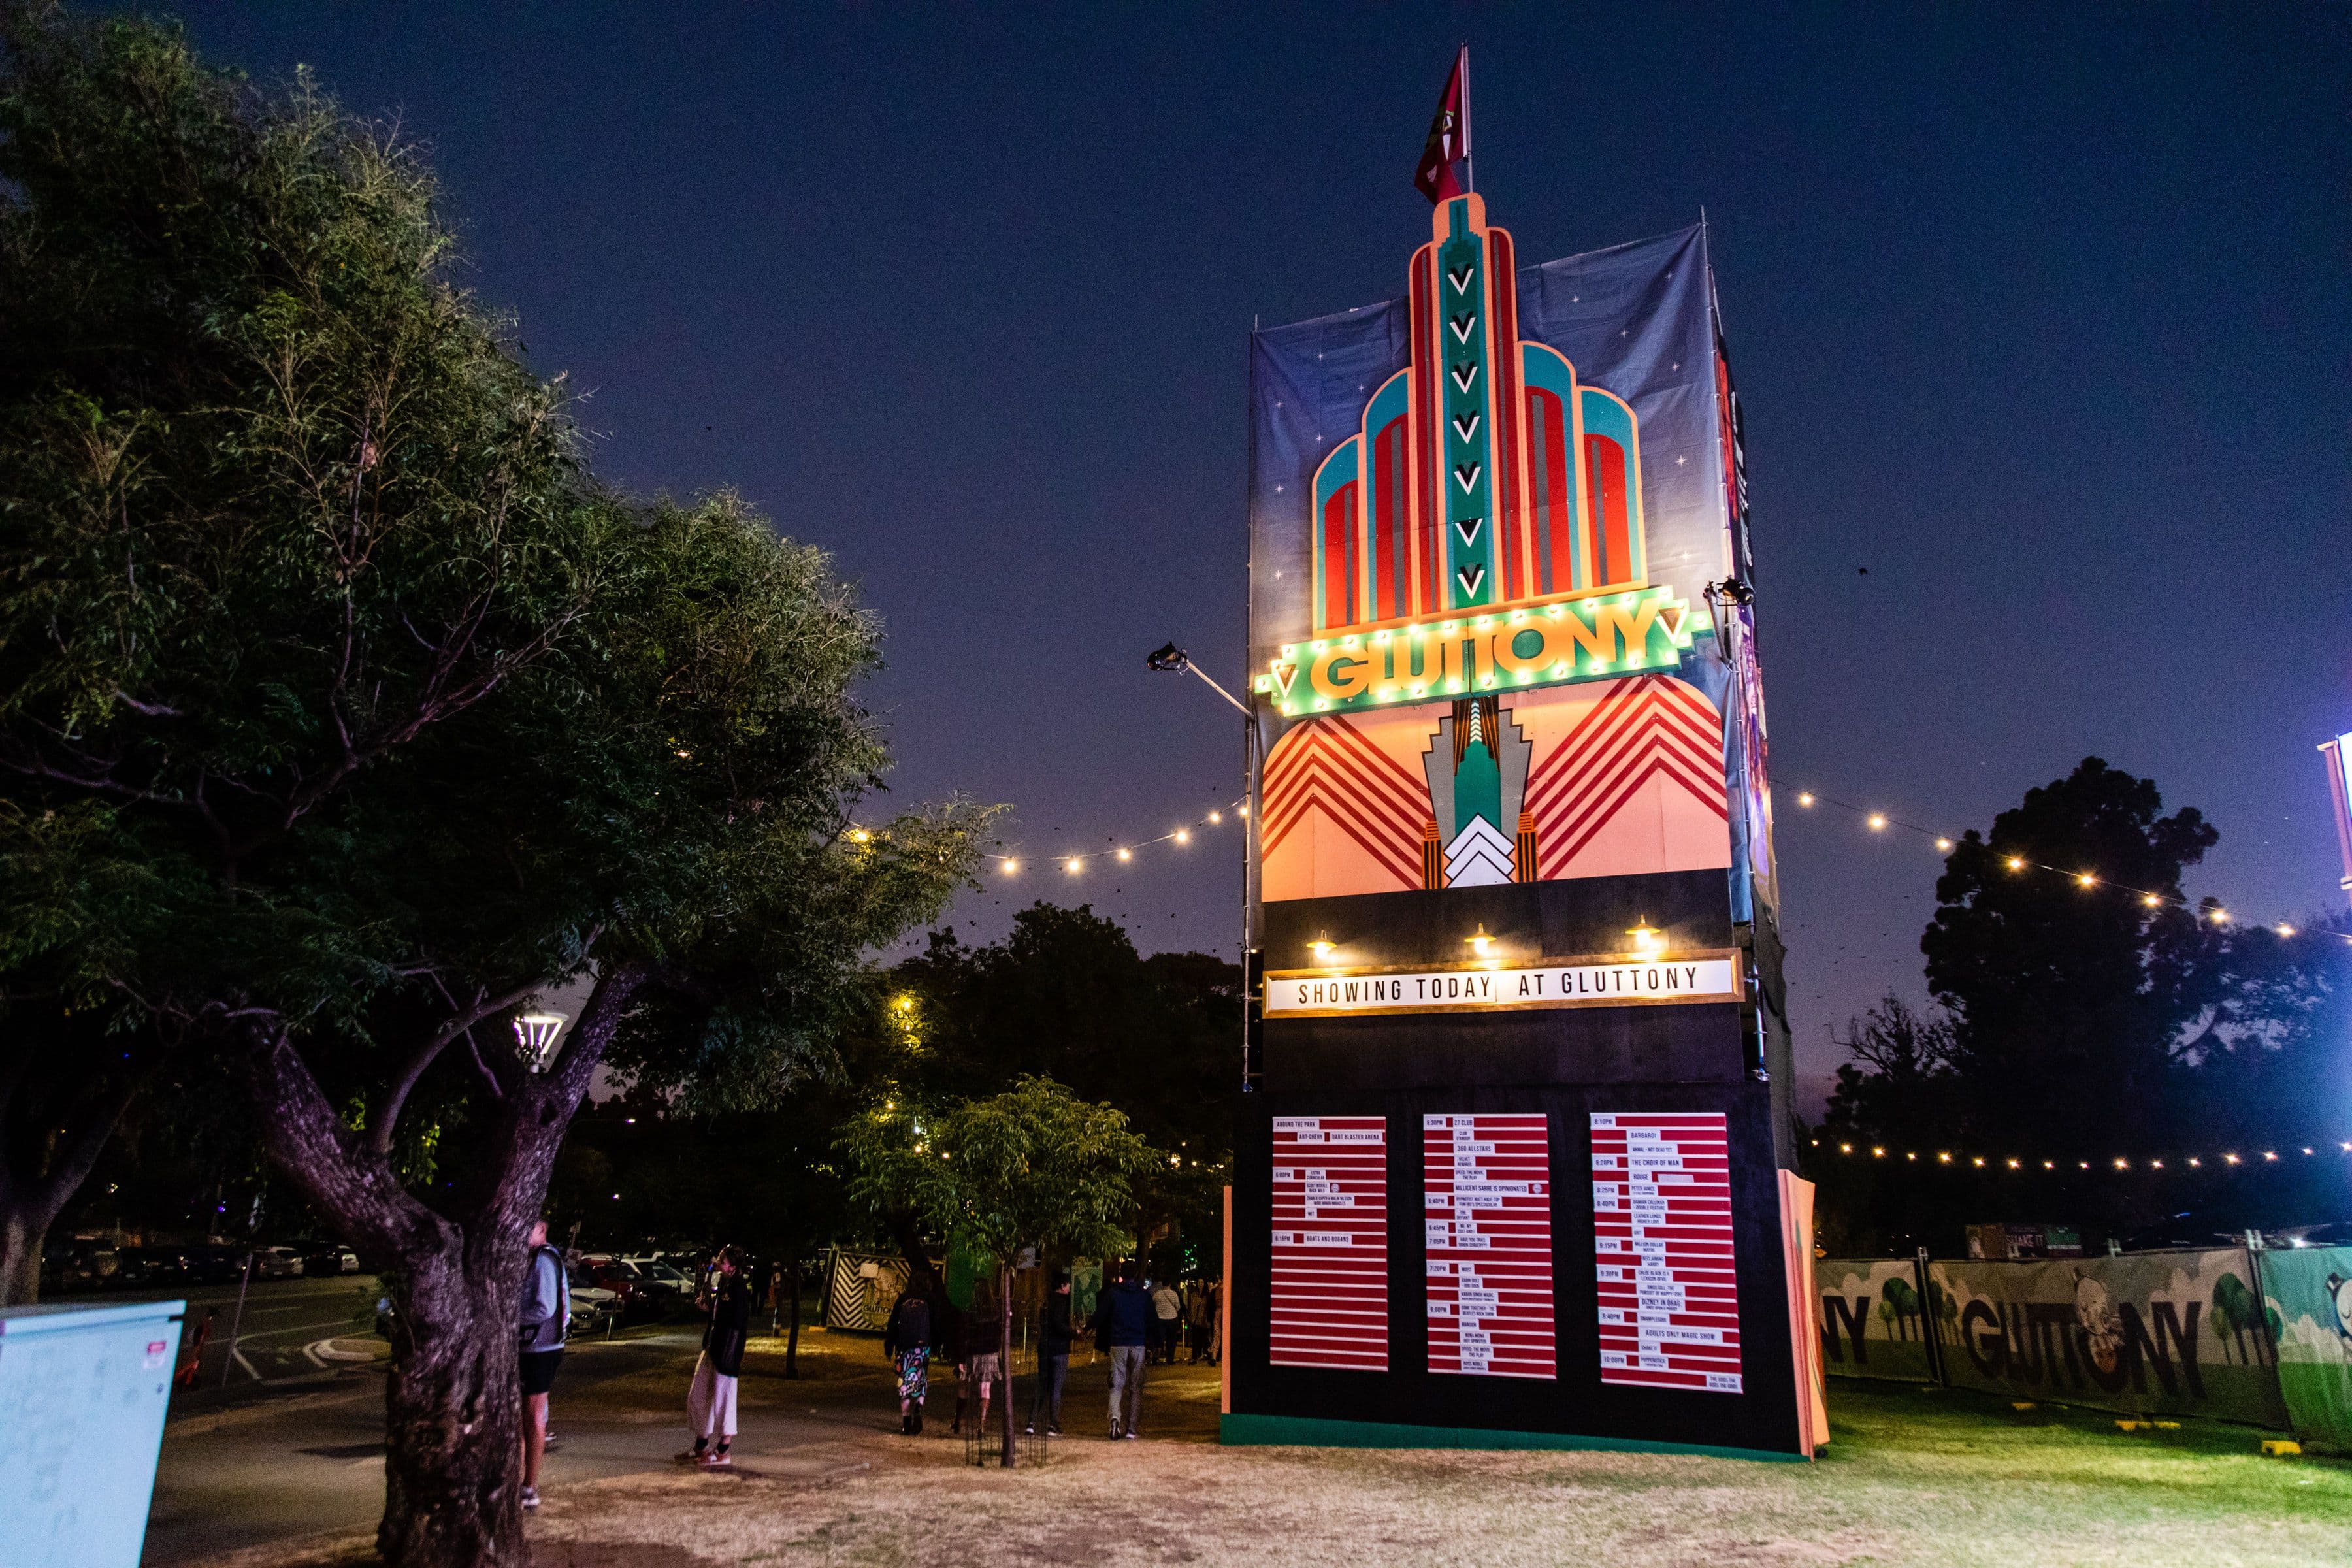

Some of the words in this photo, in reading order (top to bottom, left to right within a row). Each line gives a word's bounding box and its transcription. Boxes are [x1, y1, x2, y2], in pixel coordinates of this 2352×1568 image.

[1310, 597, 1661, 699] GLUTTONY
[1299, 979, 1401, 1004] SHOWING
[1416, 977, 1490, 1000] TODAY
[1519, 974, 1544, 995] AT
[1562, 967, 1697, 994] GLUTTONY
[863, 1305, 892, 1314] GLUTTON
